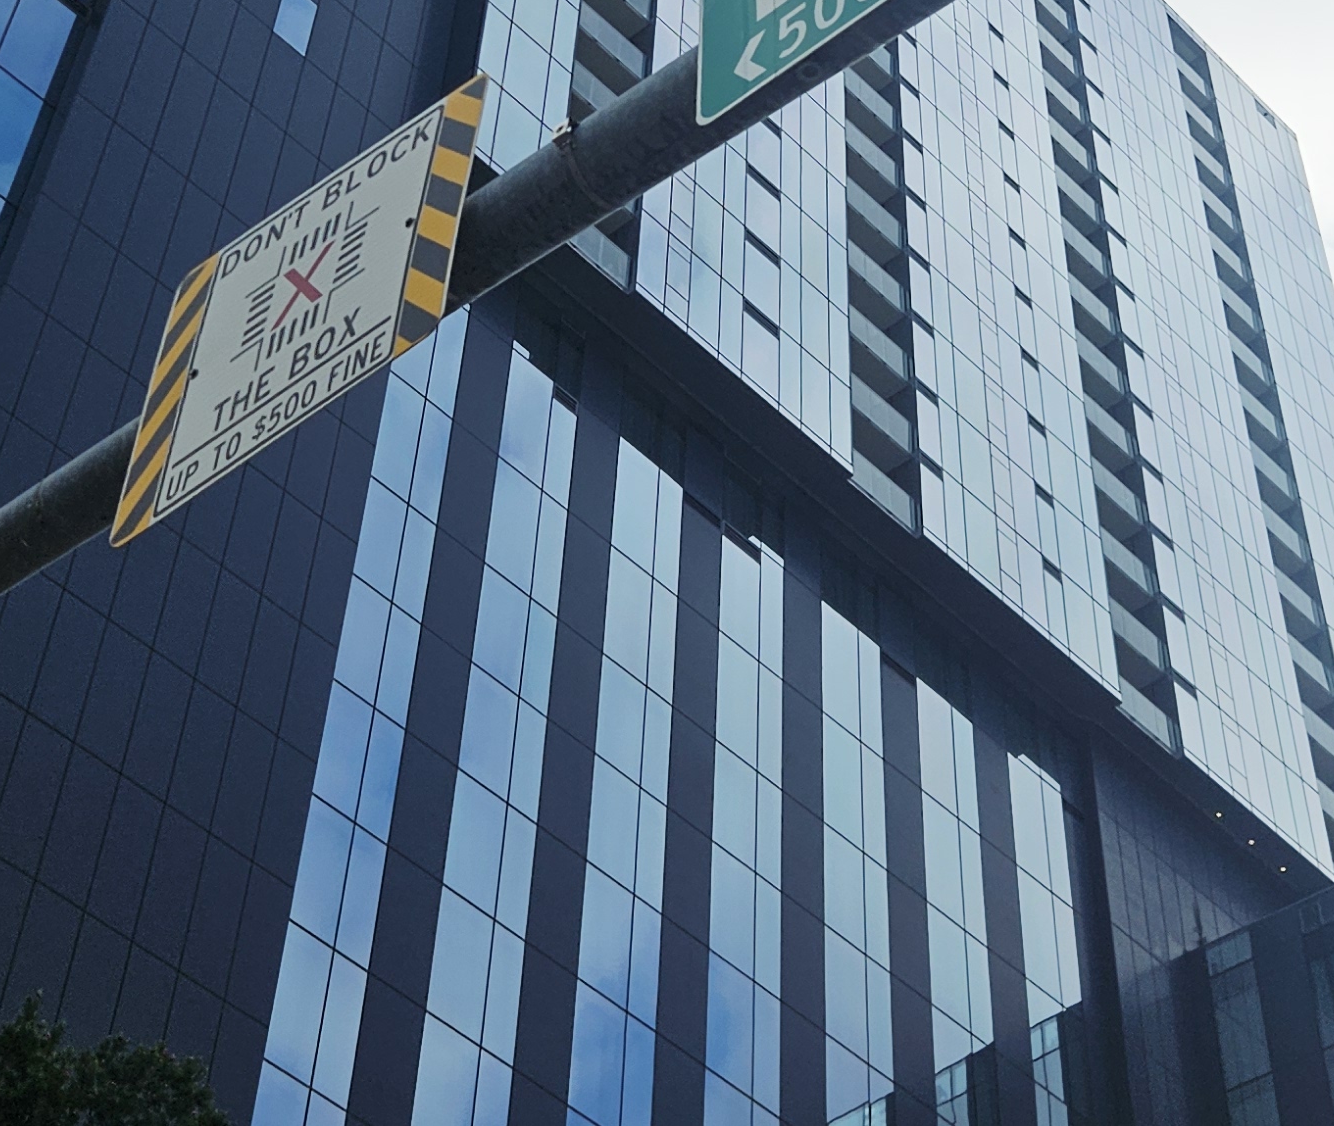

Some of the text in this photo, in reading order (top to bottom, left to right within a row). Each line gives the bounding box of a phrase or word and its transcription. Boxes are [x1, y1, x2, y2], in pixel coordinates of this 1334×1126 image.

[220, 118, 433, 281] DON'T BLOCK
[166, 335, 385, 500] UP TO $500 FINE
[214, 307, 361, 431] THE BOX
